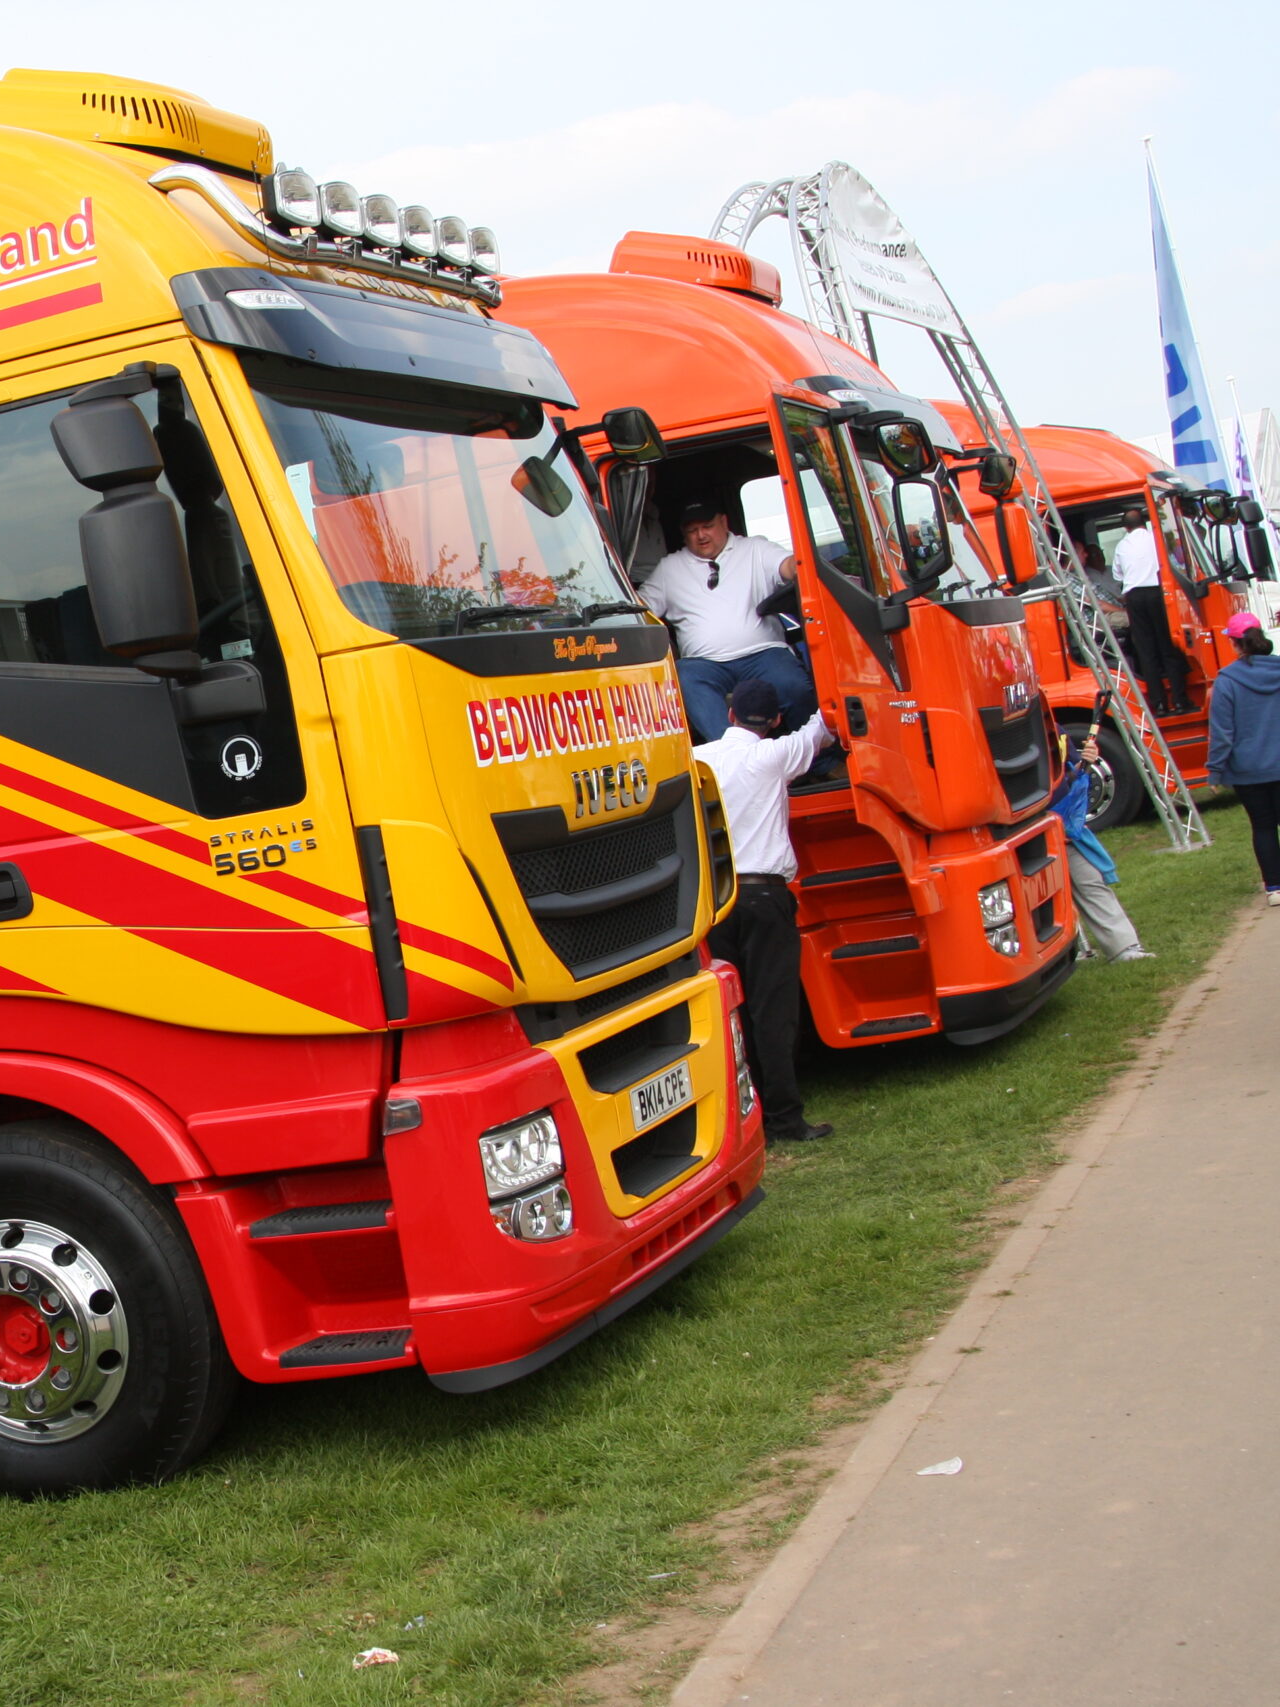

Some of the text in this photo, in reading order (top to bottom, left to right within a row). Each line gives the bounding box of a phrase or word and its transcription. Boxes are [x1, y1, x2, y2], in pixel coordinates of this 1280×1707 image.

[466, 679, 684, 767] BEDWORTH HAULAGE
[571, 758, 648, 818] IVECO
[210, 819, 314, 847] STRALIS
[214, 844, 286, 876] 560
[638, 1068, 686, 1122] BK14 CPE
